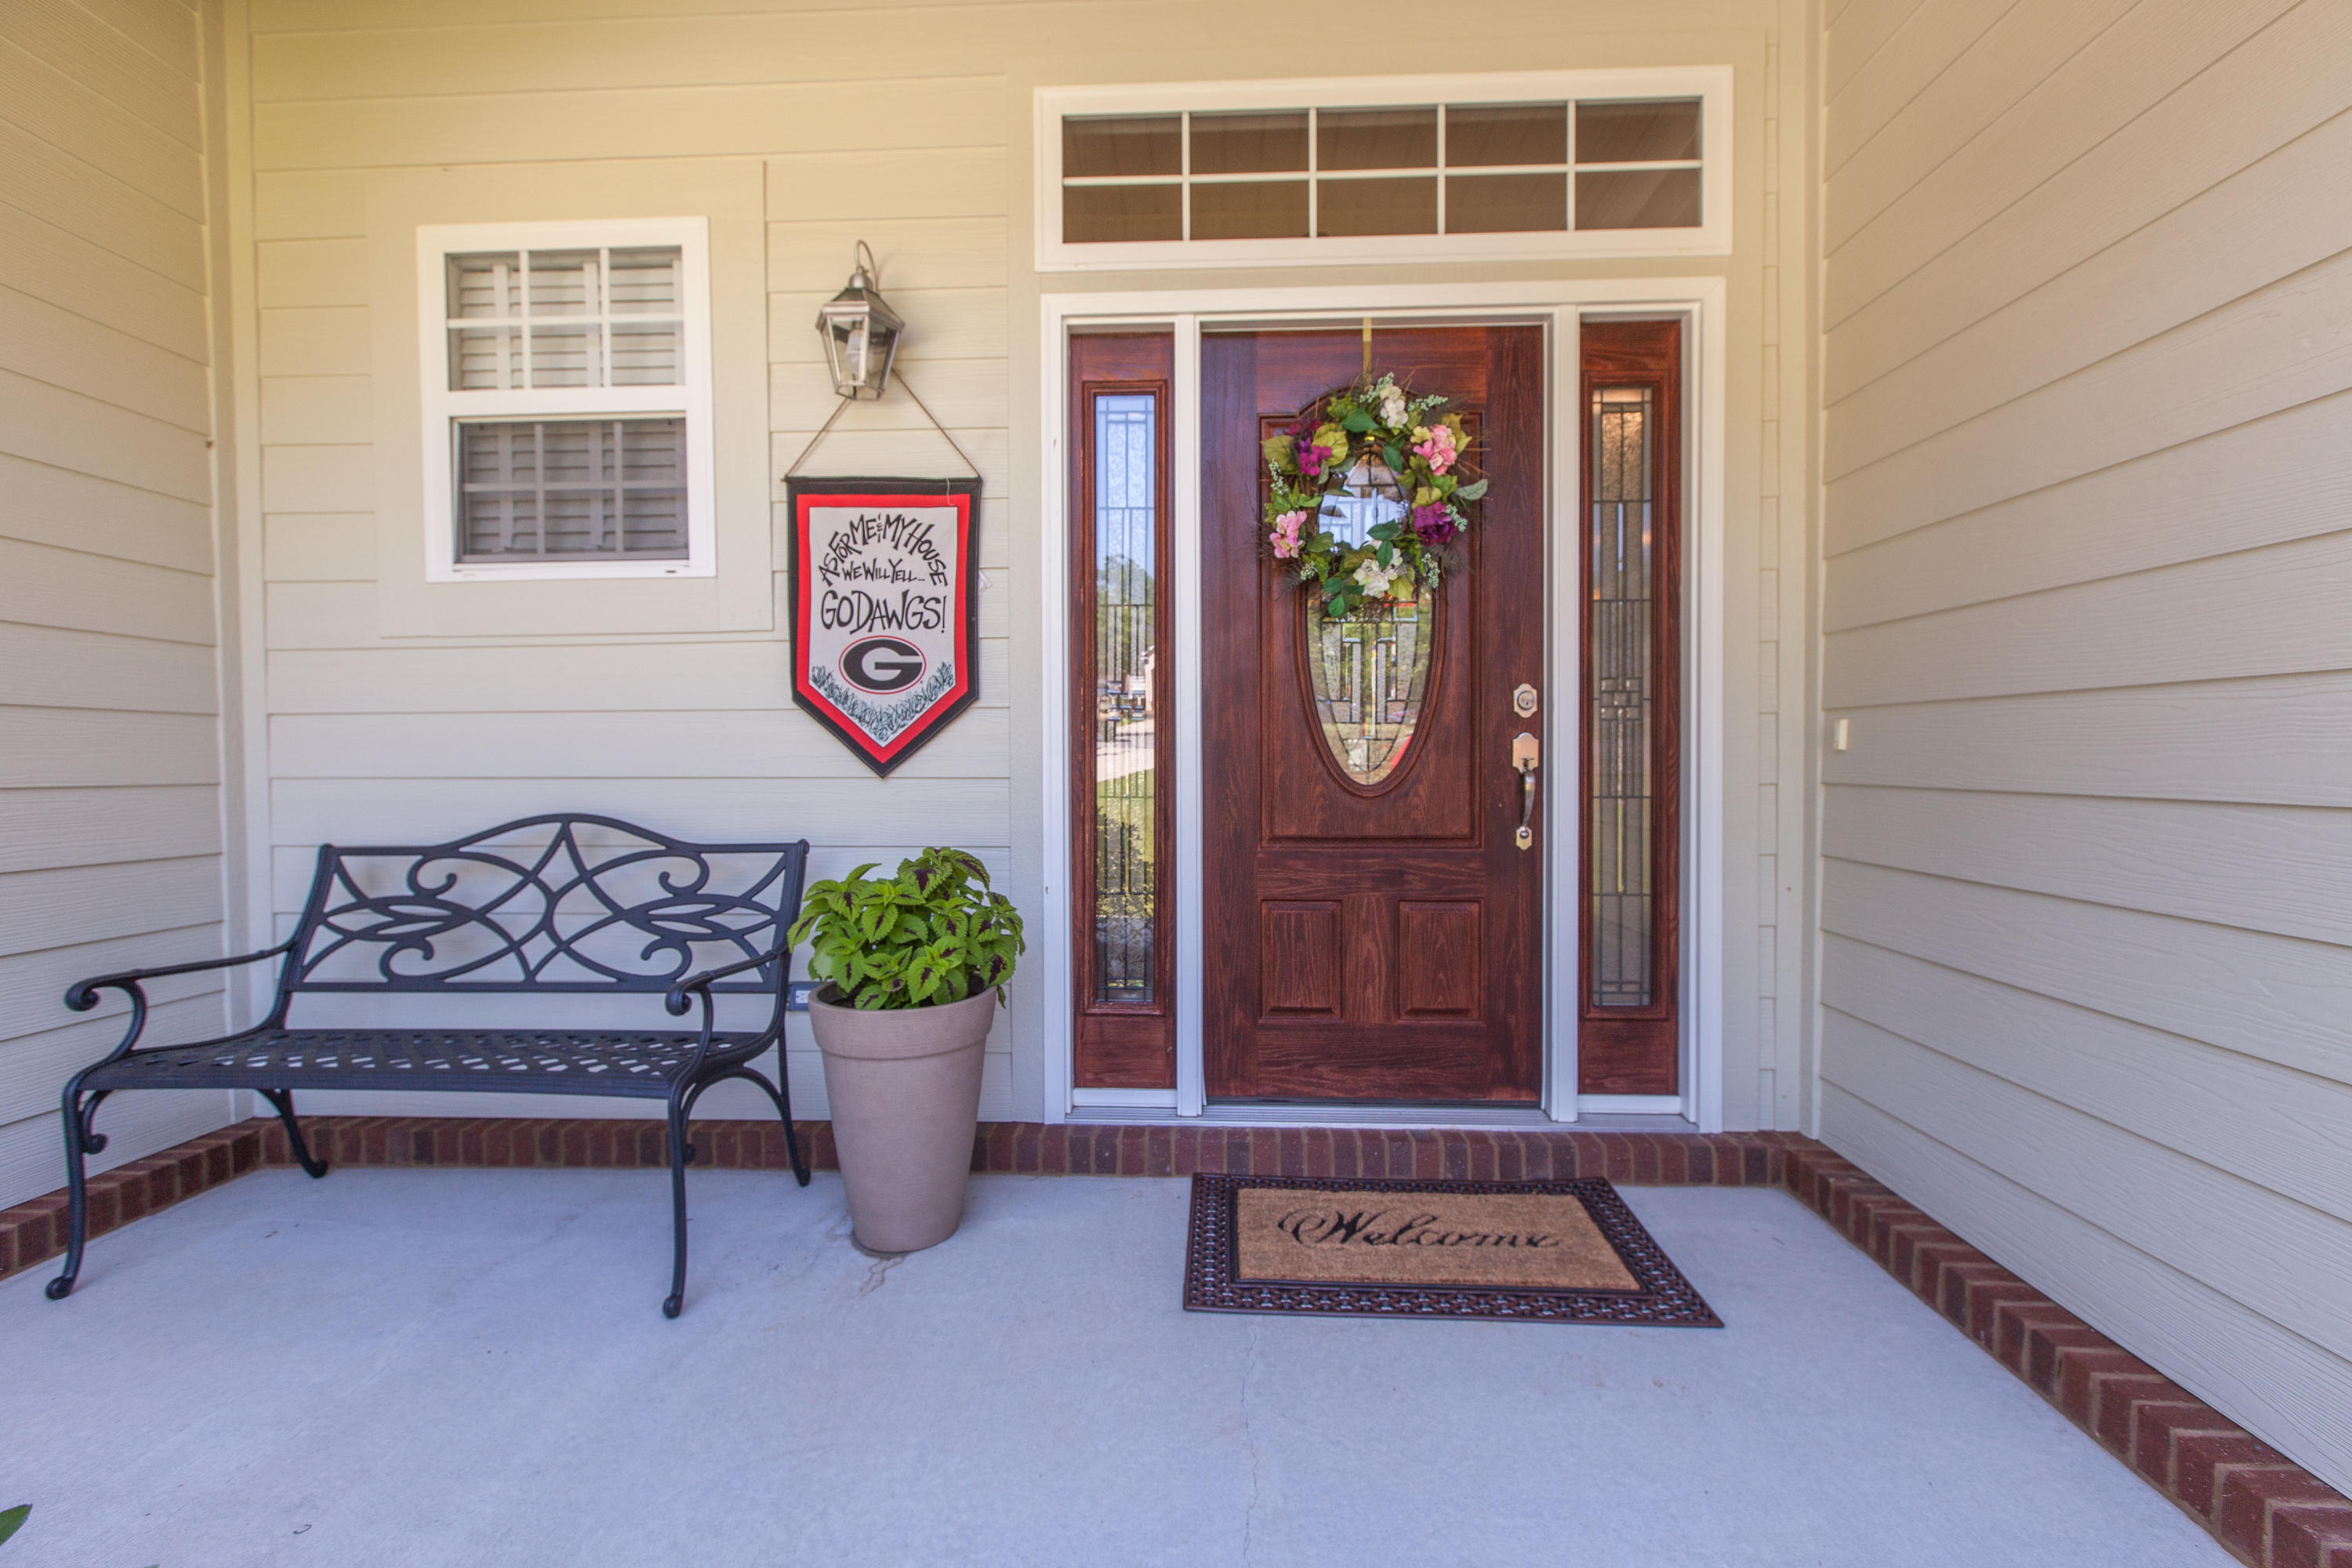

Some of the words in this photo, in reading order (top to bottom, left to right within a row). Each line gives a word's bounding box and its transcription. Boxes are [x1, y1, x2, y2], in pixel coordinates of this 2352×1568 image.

[828, 531, 862, 564] FOR
[849, 514, 877, 546] ME
[882, 514, 917, 550] MY
[818, 553, 840, 587] AS
[842, 561, 862, 581] WE
[863, 557, 890, 582] WILL
[903, 523, 948, 586] HOUSE
[821, 590, 854, 630] GO
[850, 589, 946, 635] DAWGS!
[843, 639, 923, 690] G
[1278, 1207, 1559, 1247] Welcome
